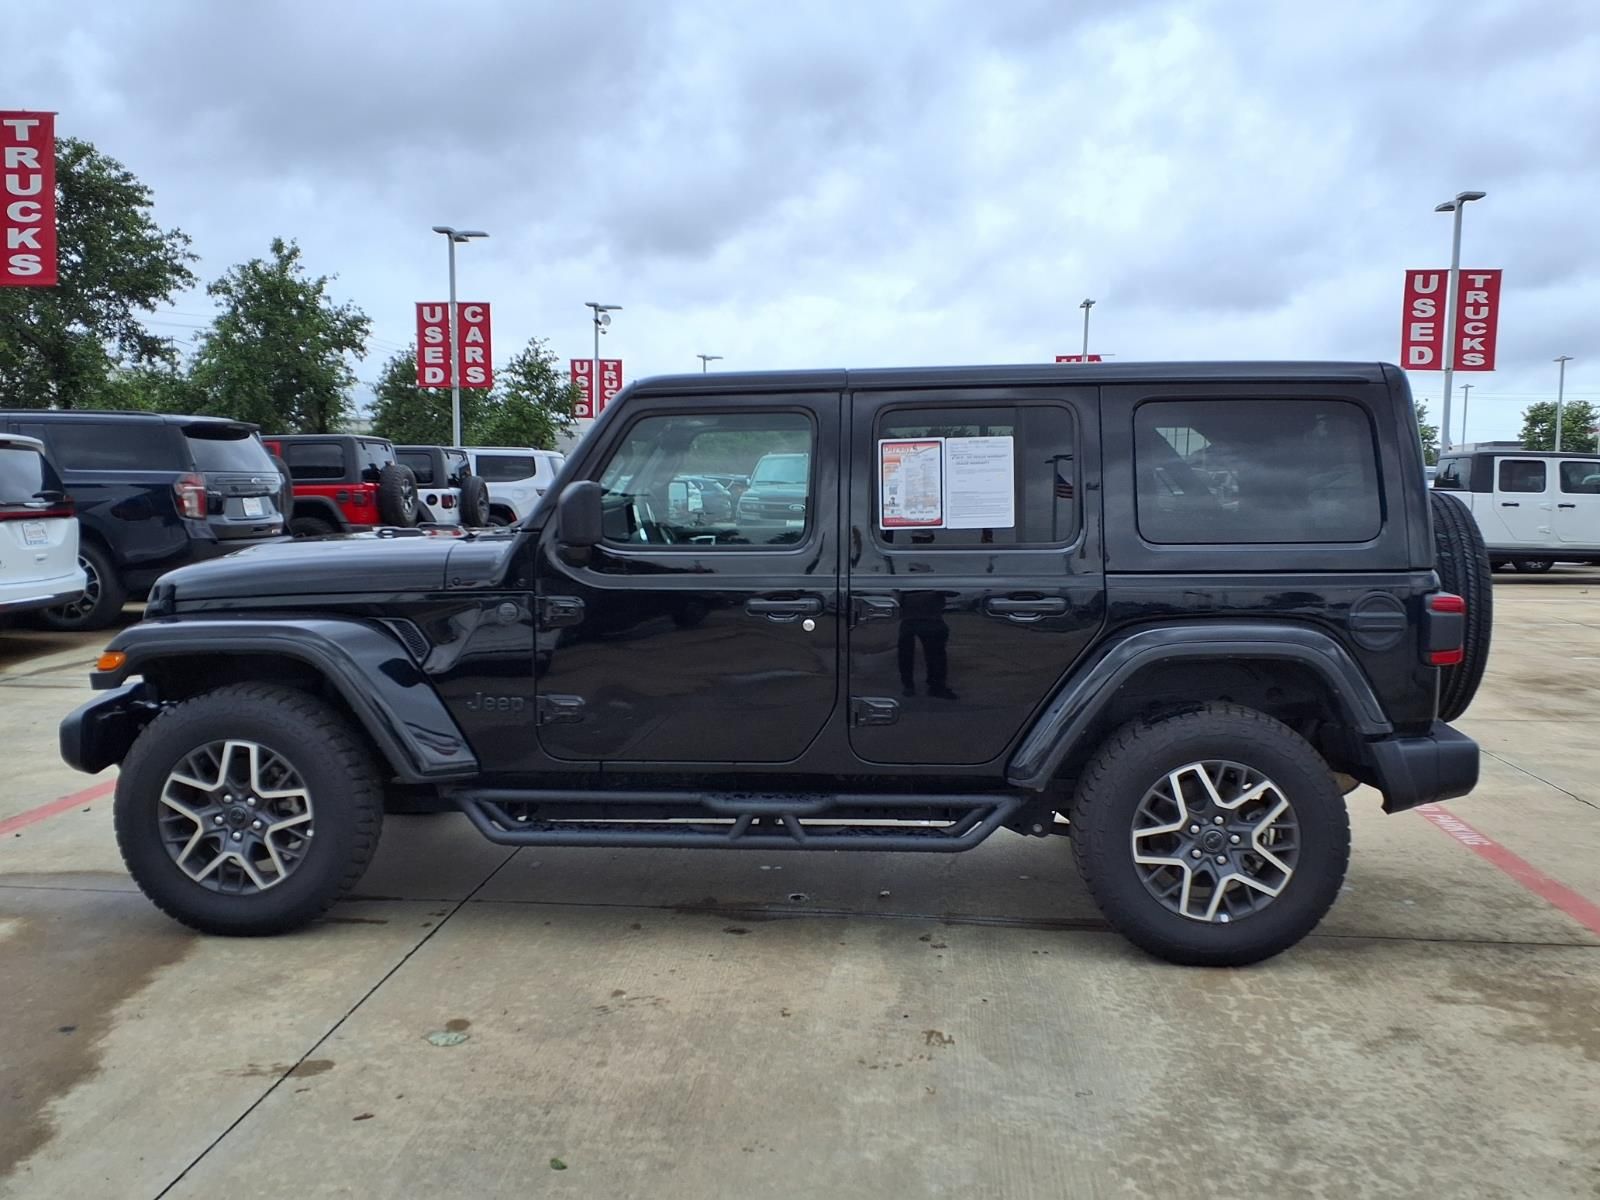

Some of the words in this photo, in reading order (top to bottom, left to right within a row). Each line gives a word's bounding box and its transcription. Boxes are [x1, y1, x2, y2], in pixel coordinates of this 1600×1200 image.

[3, 119, 42, 276] TRUCKS
[422, 306, 445, 384] USED
[463, 305, 486, 384] CARS
[1408, 274, 1439, 365] USED
[1461, 274, 1492, 366] TRUCKS
[574, 361, 589, 416] USED
[464, 691, 525, 712] Jeep
